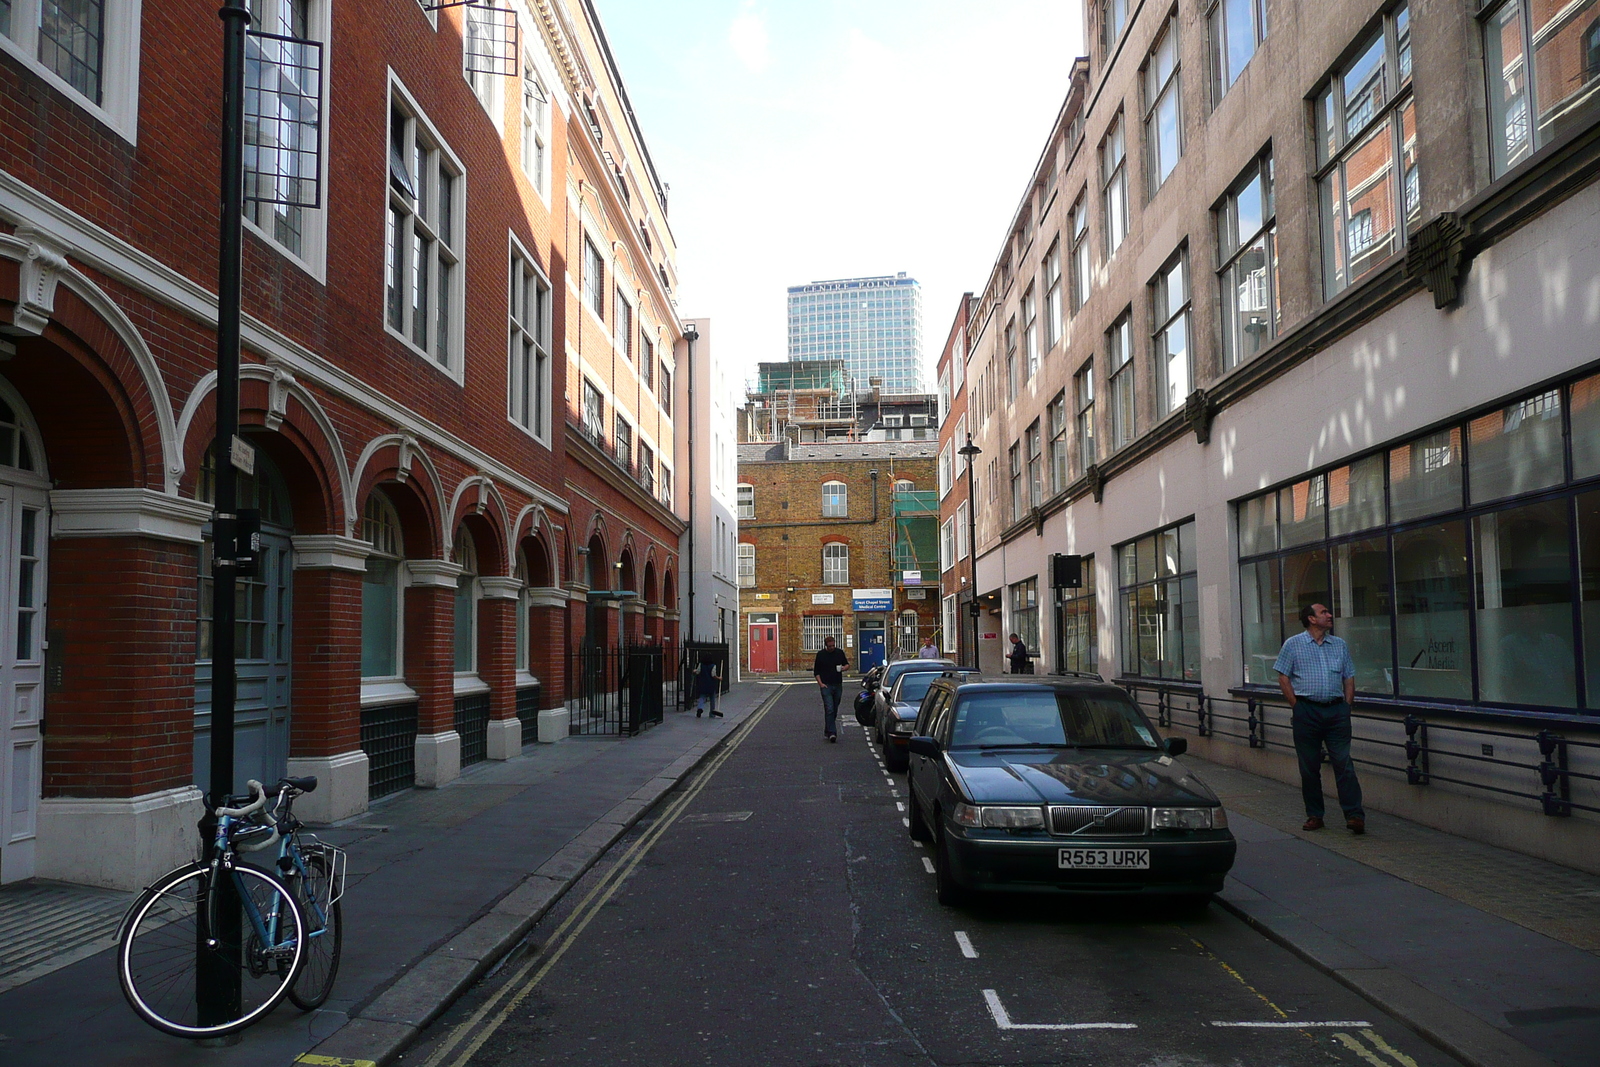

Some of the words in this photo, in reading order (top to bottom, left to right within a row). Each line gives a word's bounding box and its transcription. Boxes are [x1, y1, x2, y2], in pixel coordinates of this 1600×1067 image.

[803, 283, 849, 293] CENTRE
[859, 280, 897, 289] POINT
[1427, 637, 1455, 653] Ascent
[1428, 656, 1455, 669] Media
[1060, 850, 1108, 865] R553
[1113, 850, 1148, 865] URK
